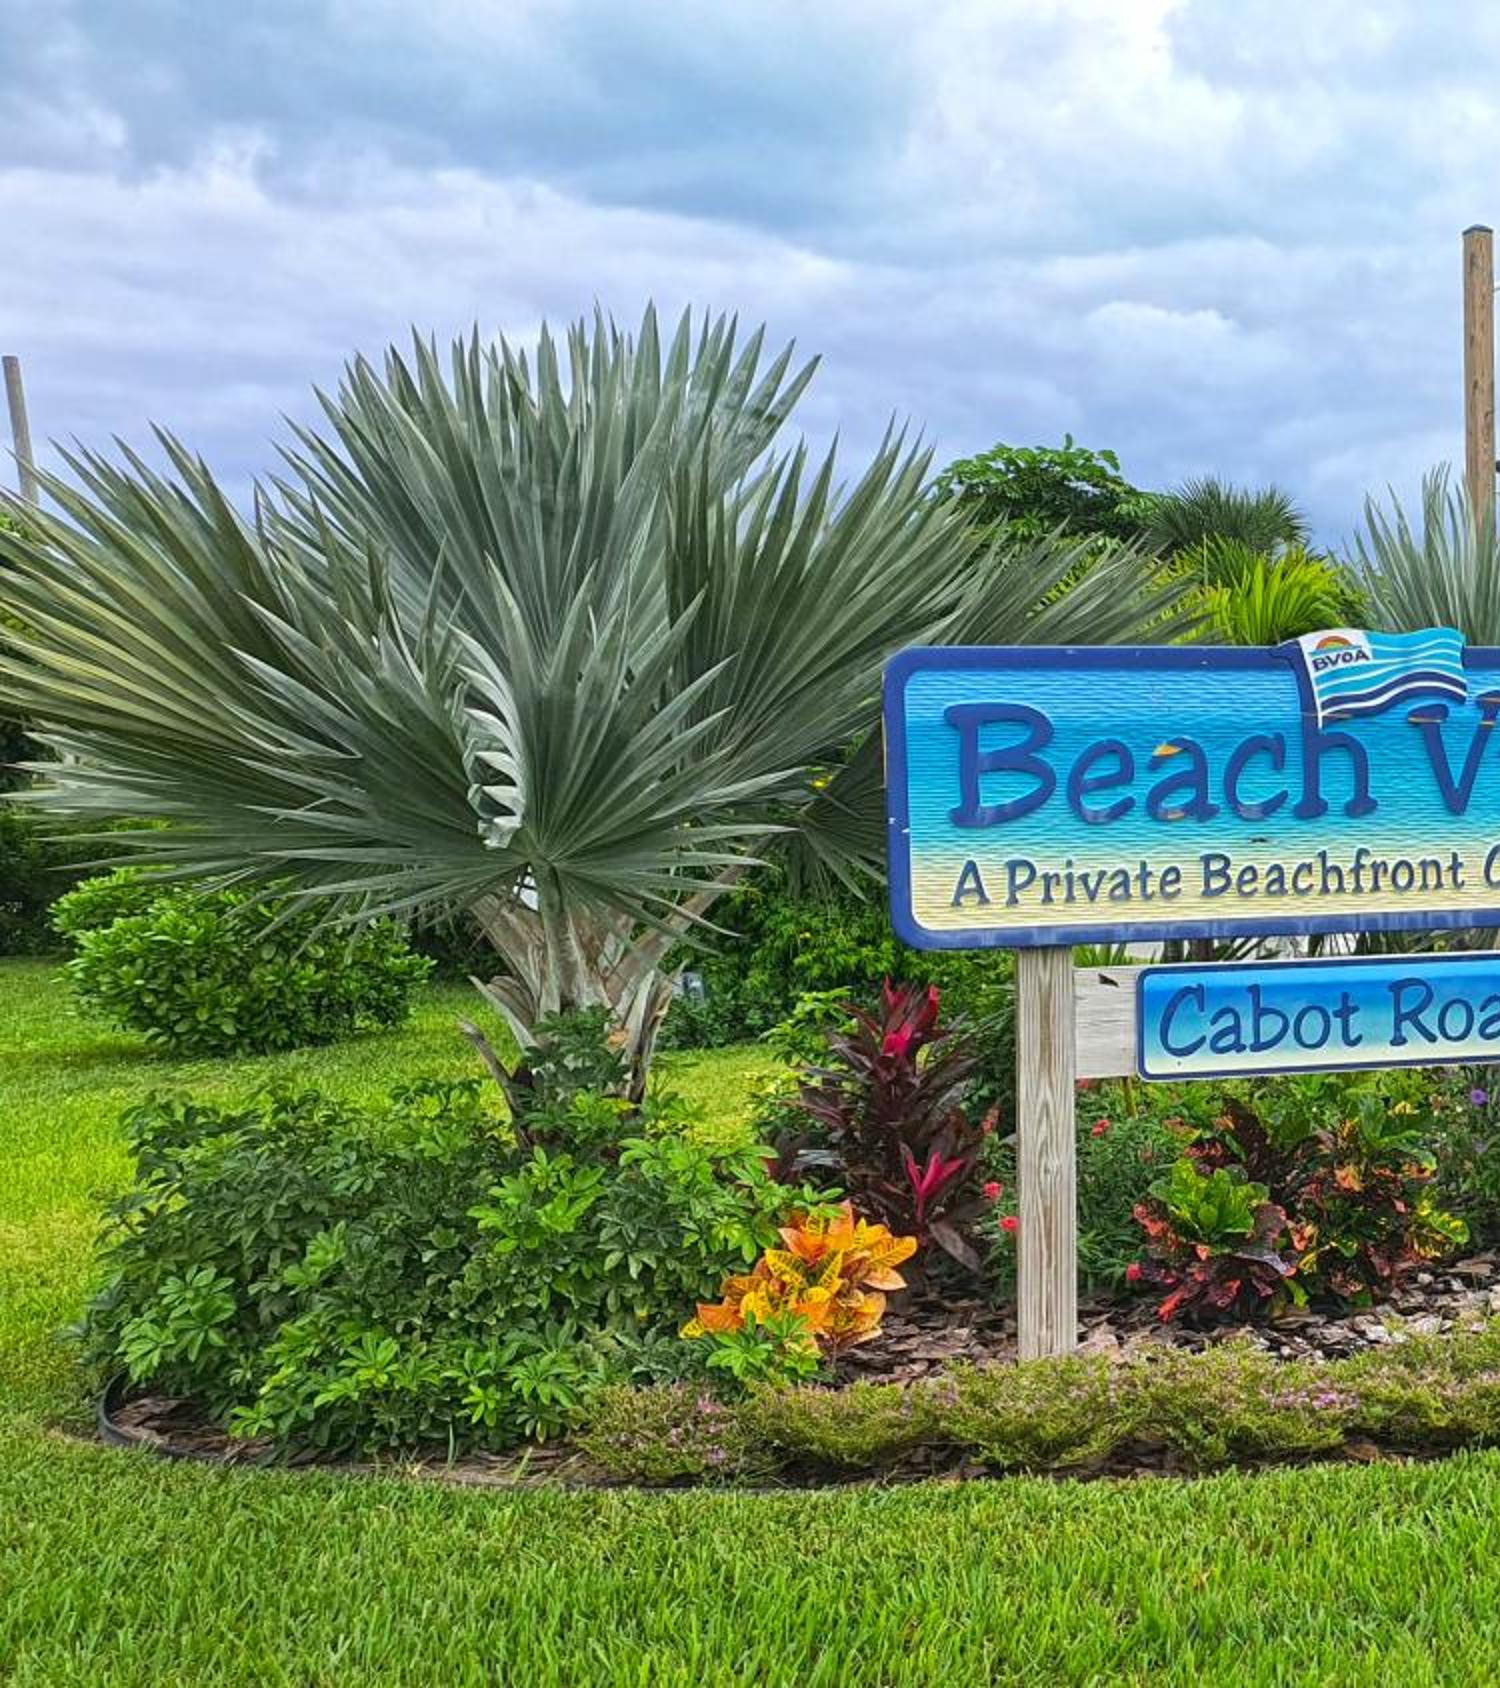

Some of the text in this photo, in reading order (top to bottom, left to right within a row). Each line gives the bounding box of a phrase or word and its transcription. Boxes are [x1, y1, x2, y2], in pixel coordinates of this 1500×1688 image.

[943, 700, 1379, 829] Beach
[950, 860, 991, 907] A
[1005, 859, 1183, 907] Private
[1200, 847, 1466, 898] Beachfront
[1159, 983, 1364, 1057] Cabot
